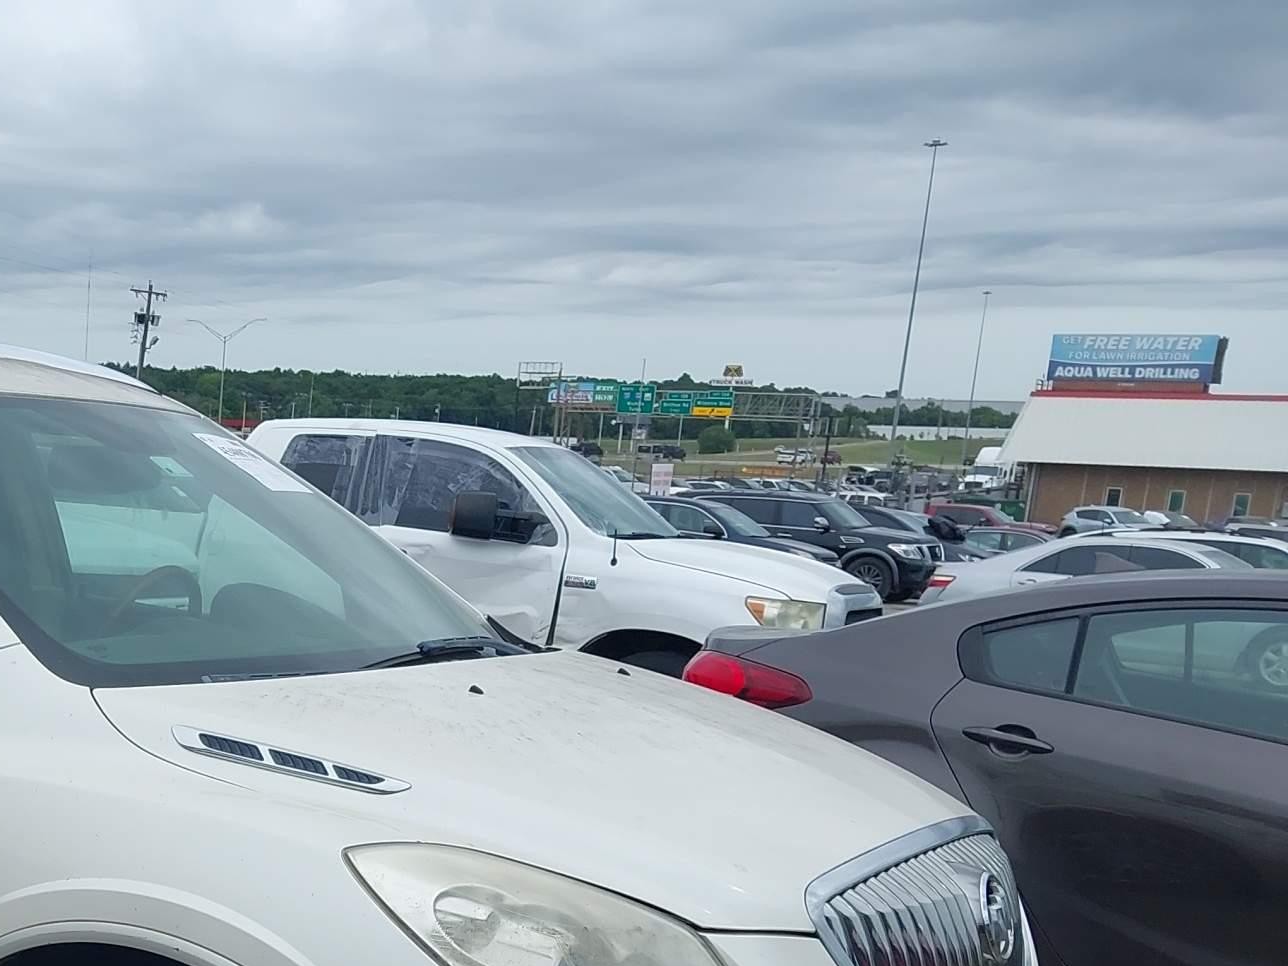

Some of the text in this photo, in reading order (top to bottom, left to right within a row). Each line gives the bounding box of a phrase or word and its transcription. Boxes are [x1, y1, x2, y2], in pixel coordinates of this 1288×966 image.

[1062, 335, 1202, 351] GET FREE WATER
[1068, 351, 1191, 361] FOR LAWN IRRIGATION
[1054, 366, 1200, 380] AQUA WELL DRILLING
